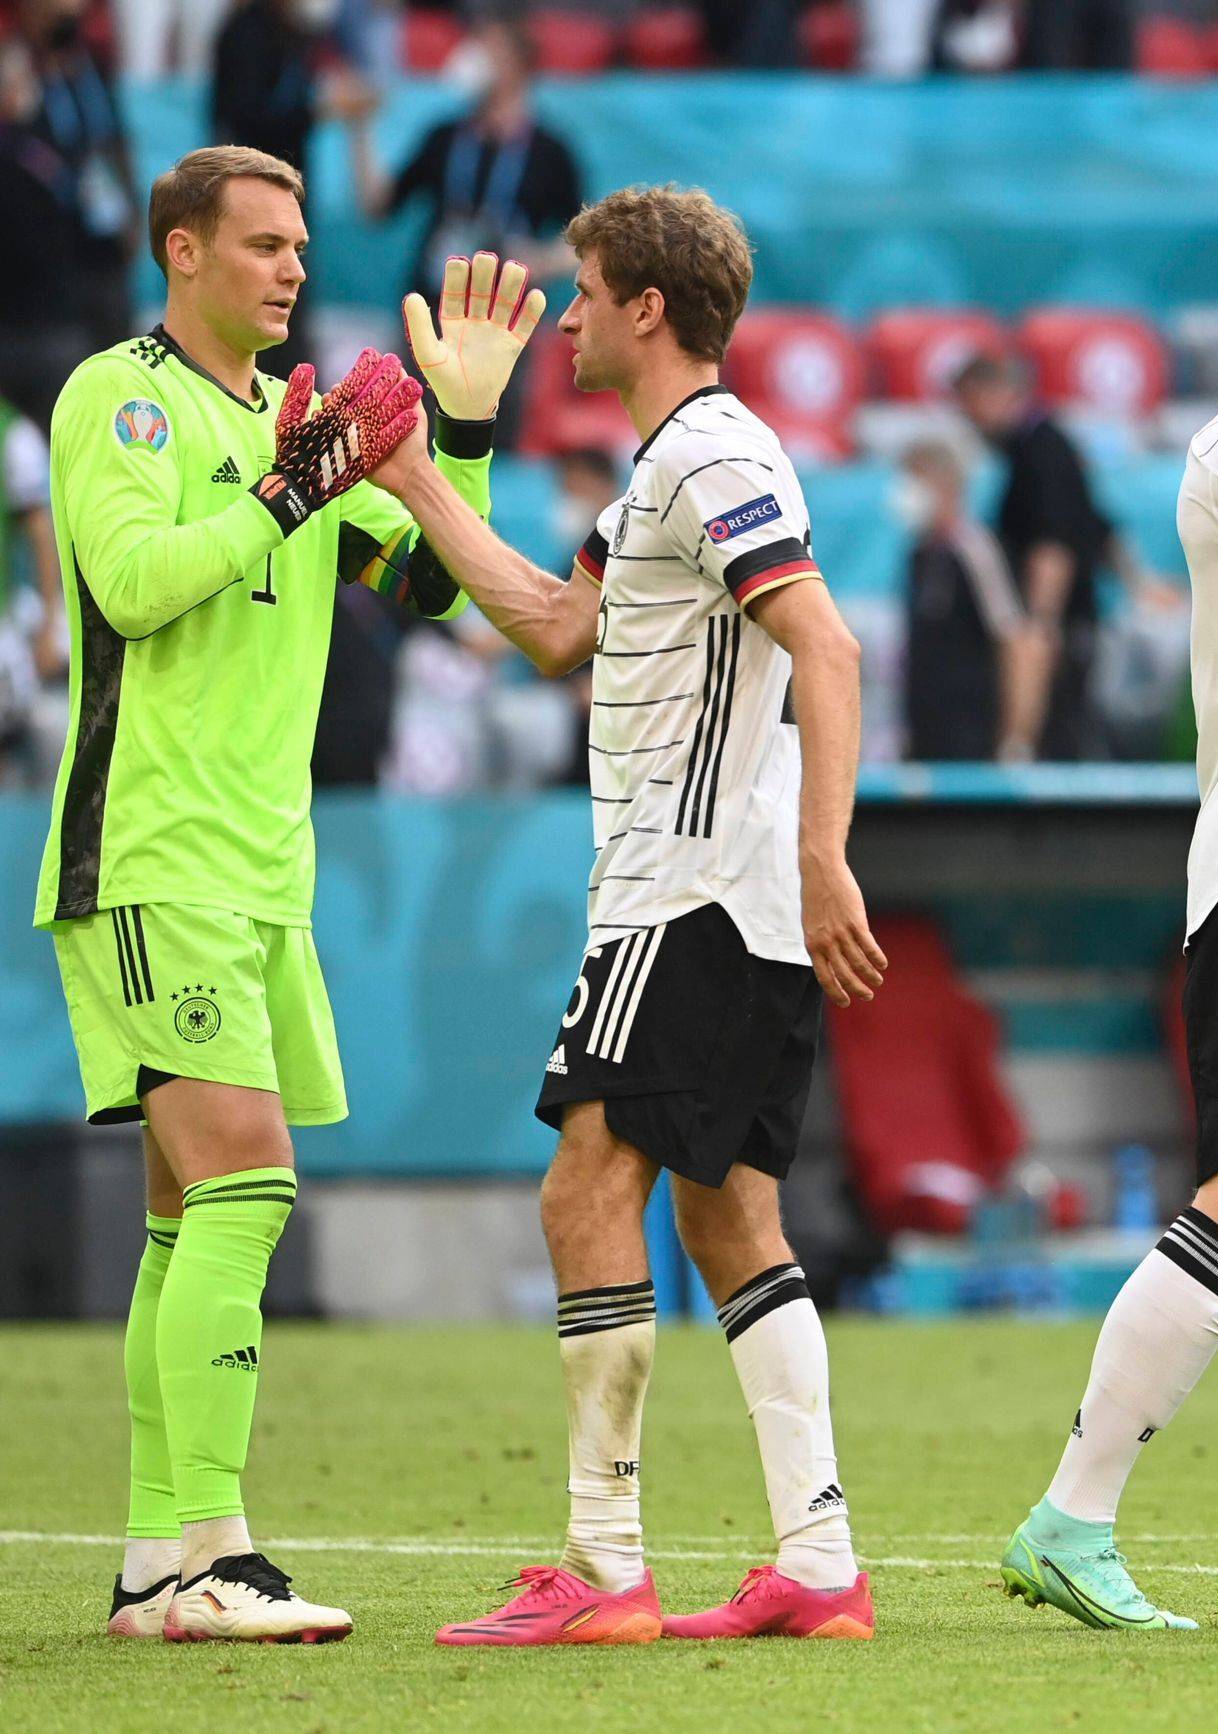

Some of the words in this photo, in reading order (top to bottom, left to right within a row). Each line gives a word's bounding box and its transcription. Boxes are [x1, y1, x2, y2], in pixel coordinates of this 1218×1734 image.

[211, 473, 241, 484] adida
[287, 488, 308, 517] MANUEL
[727, 500, 779, 531] RESPECT
[251, 551, 277, 606] 1
[211, 1358, 259, 1373] adida
[614, 1460, 641, 1477] DF
